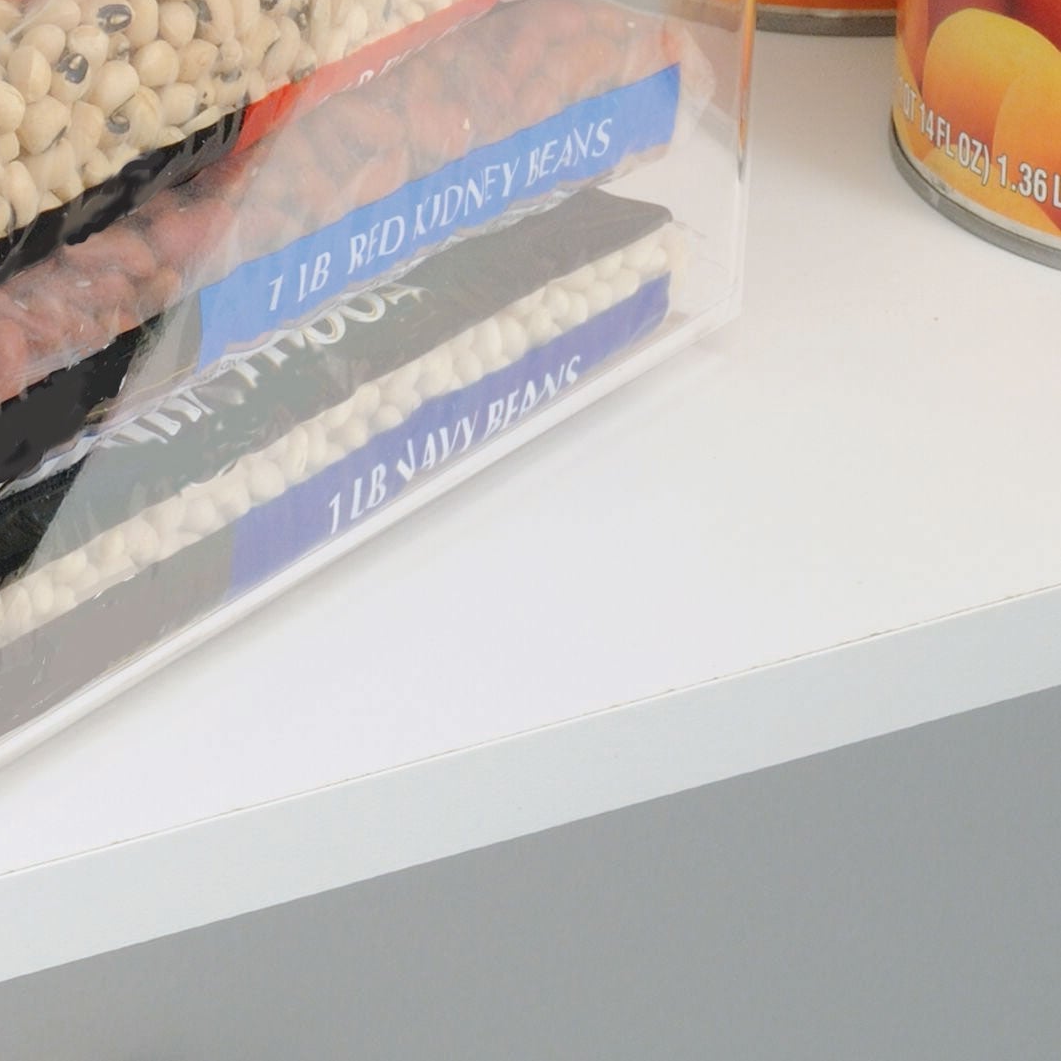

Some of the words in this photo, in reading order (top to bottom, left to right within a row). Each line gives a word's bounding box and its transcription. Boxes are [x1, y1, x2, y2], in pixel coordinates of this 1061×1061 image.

[268, 274, 284, 312] 1
[298, 251, 331, 303] LB
[347, 215, 405, 275] RED
[412, 155, 520, 241] KIDNEY
[524, 118, 613, 188] BEANS
[996, 153, 1048, 204] 1.36
[328, 491, 341, 536] 1
[350, 463, 387, 521] LB
[483, 355, 581, 441] BEANS
